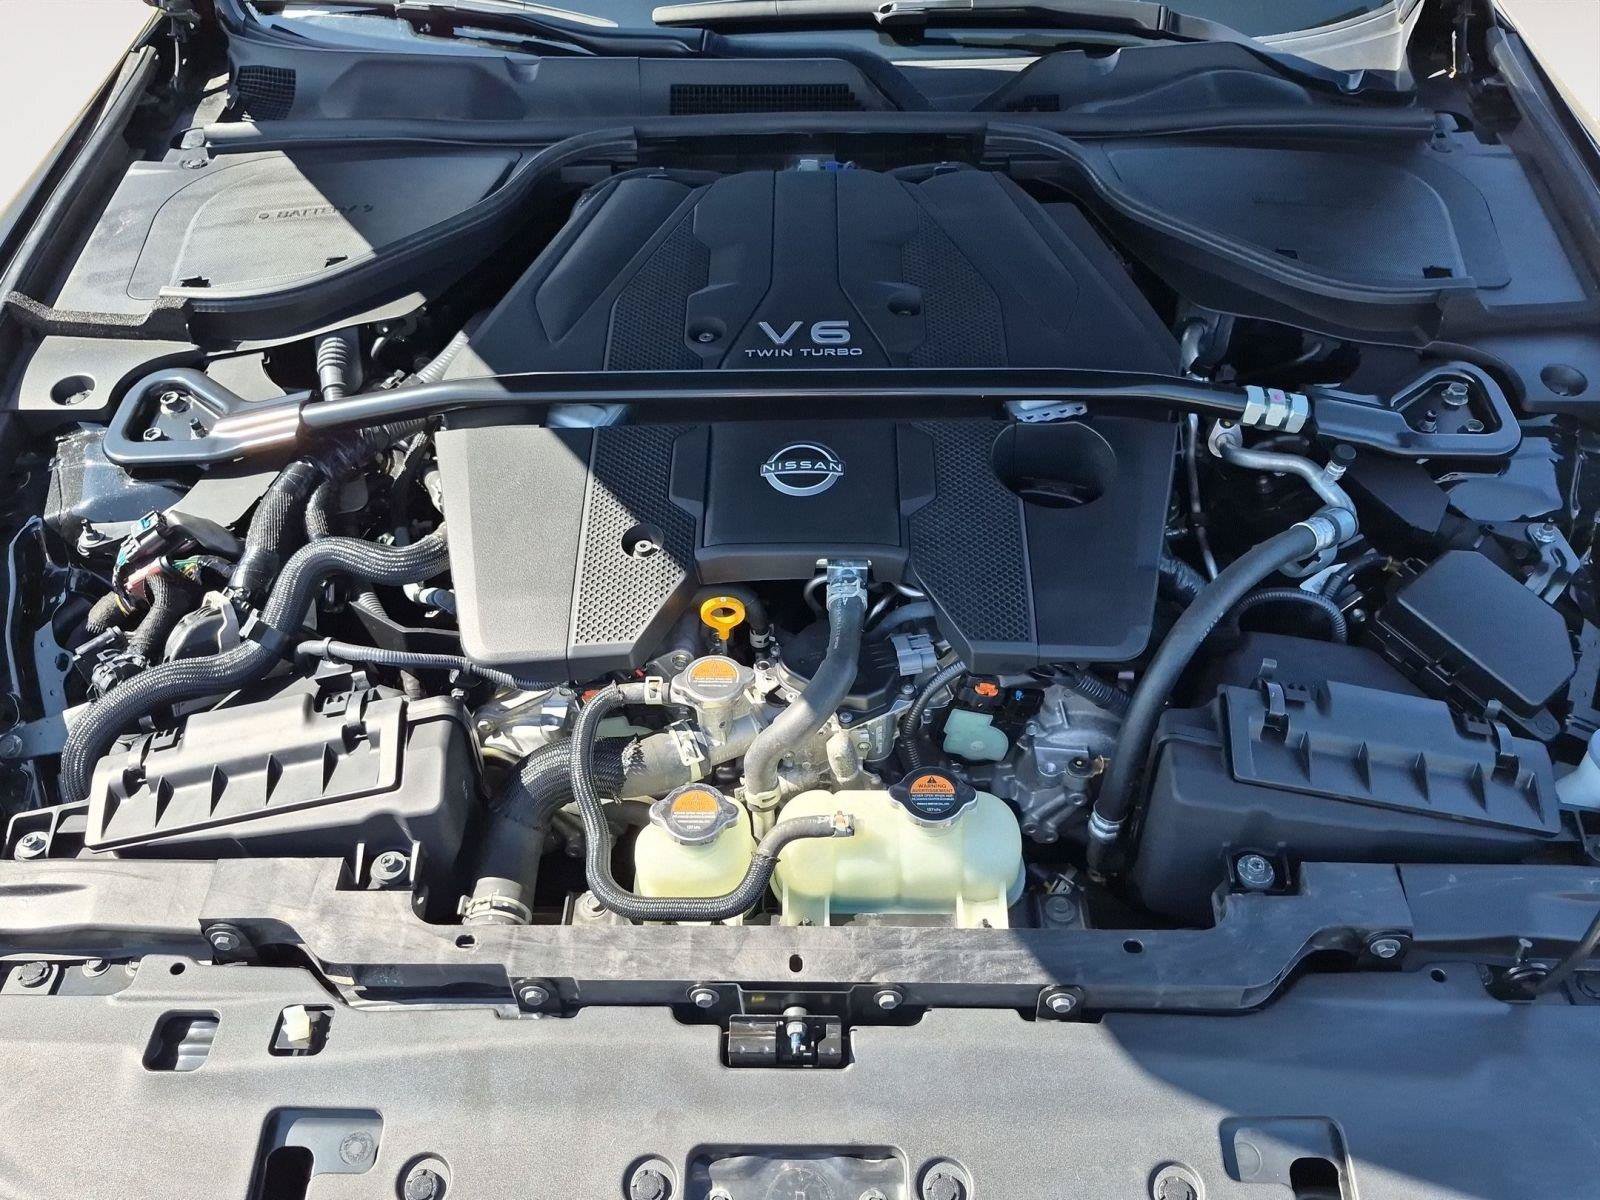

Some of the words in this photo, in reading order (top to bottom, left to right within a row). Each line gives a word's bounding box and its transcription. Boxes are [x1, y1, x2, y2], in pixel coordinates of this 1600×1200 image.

[744, 349, 793, 357] TWIN
[799, 348, 863, 356] TURBO
[762, 461, 842, 472] NISSAN
